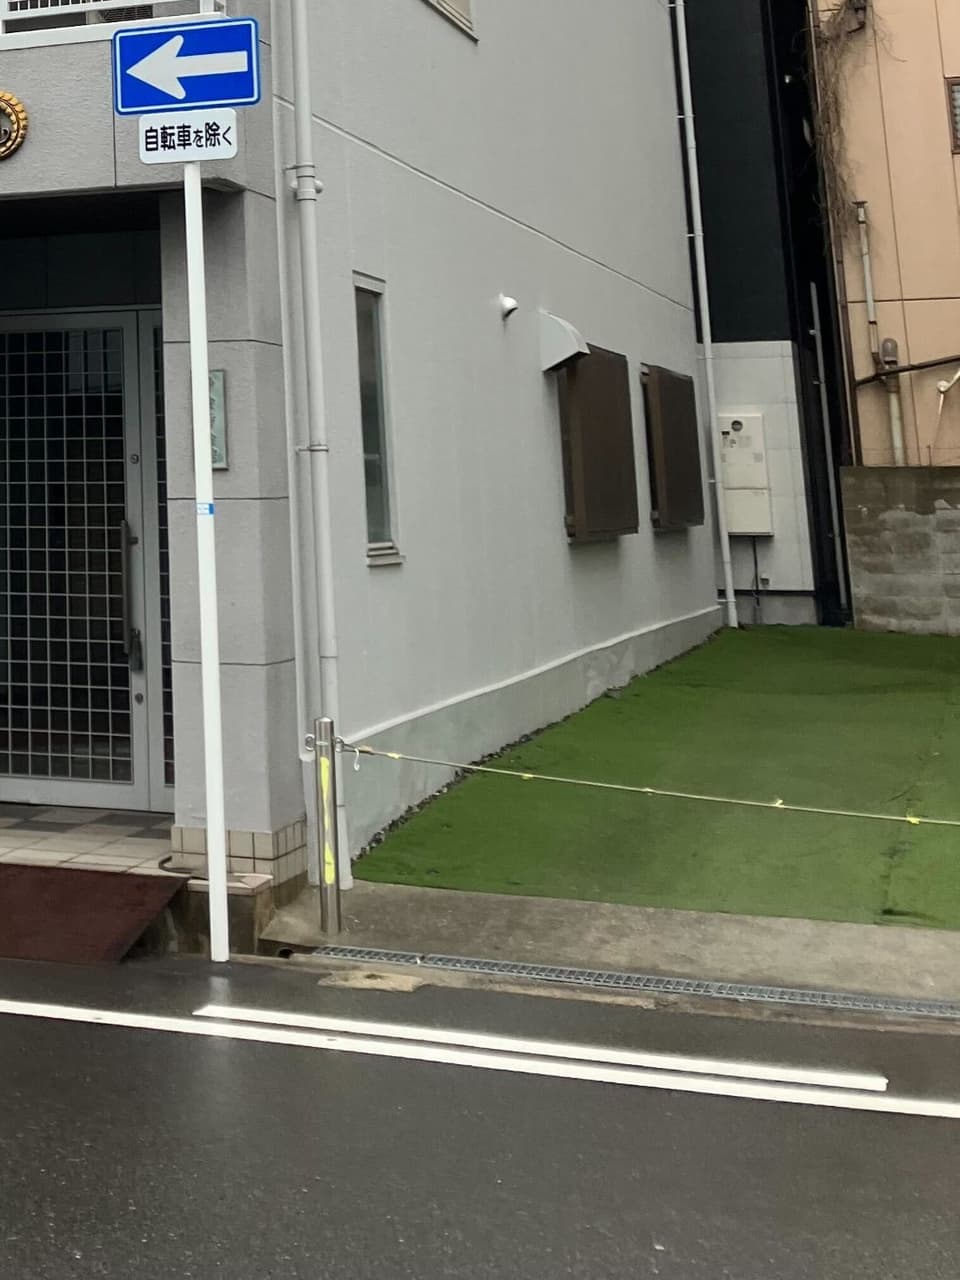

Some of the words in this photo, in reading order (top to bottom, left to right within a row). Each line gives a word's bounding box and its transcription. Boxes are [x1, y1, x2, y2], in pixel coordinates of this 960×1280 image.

[145, 122, 232, 151] 自転車を除く
